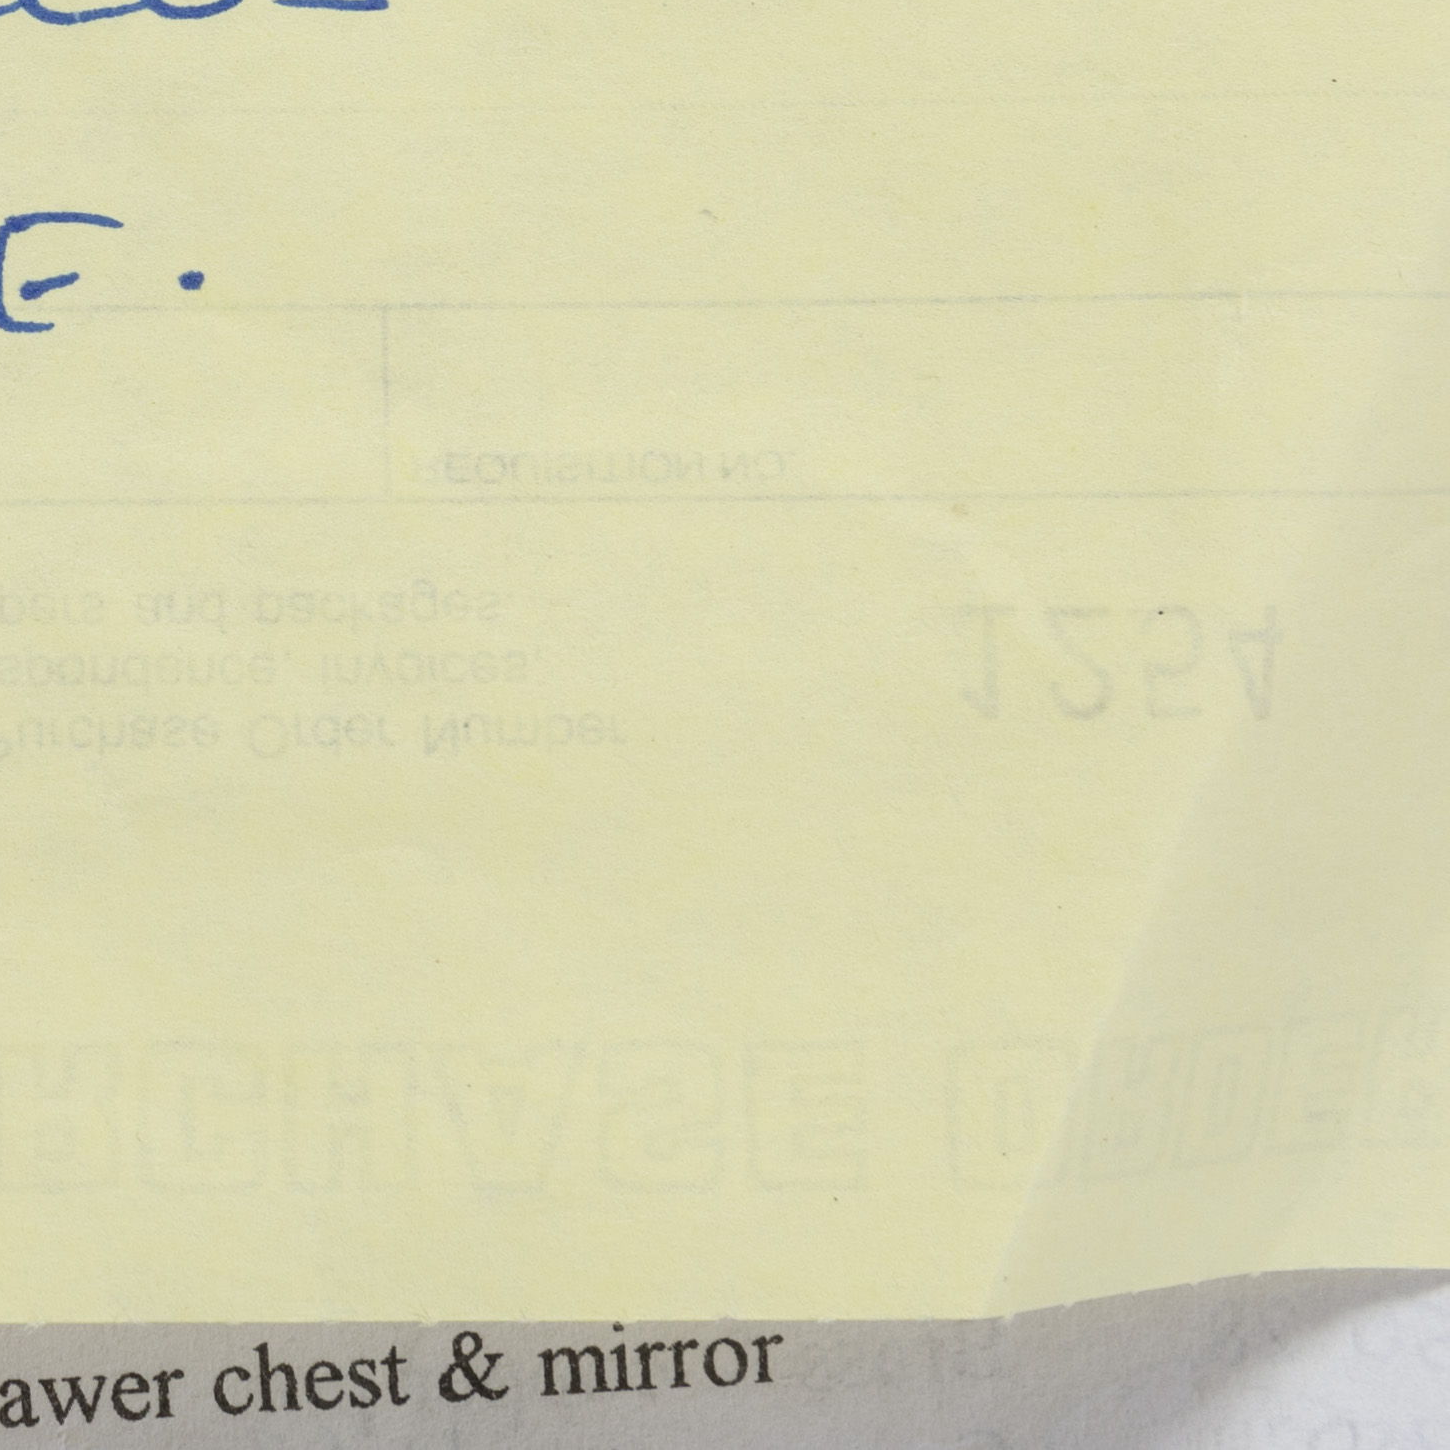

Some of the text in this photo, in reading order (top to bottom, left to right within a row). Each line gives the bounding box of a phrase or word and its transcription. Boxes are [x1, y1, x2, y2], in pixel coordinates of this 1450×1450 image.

[214, 1343, 410, 1416] chest
[439, 1331, 509, 1402] &
[538, 1325, 783, 1396] mirror
